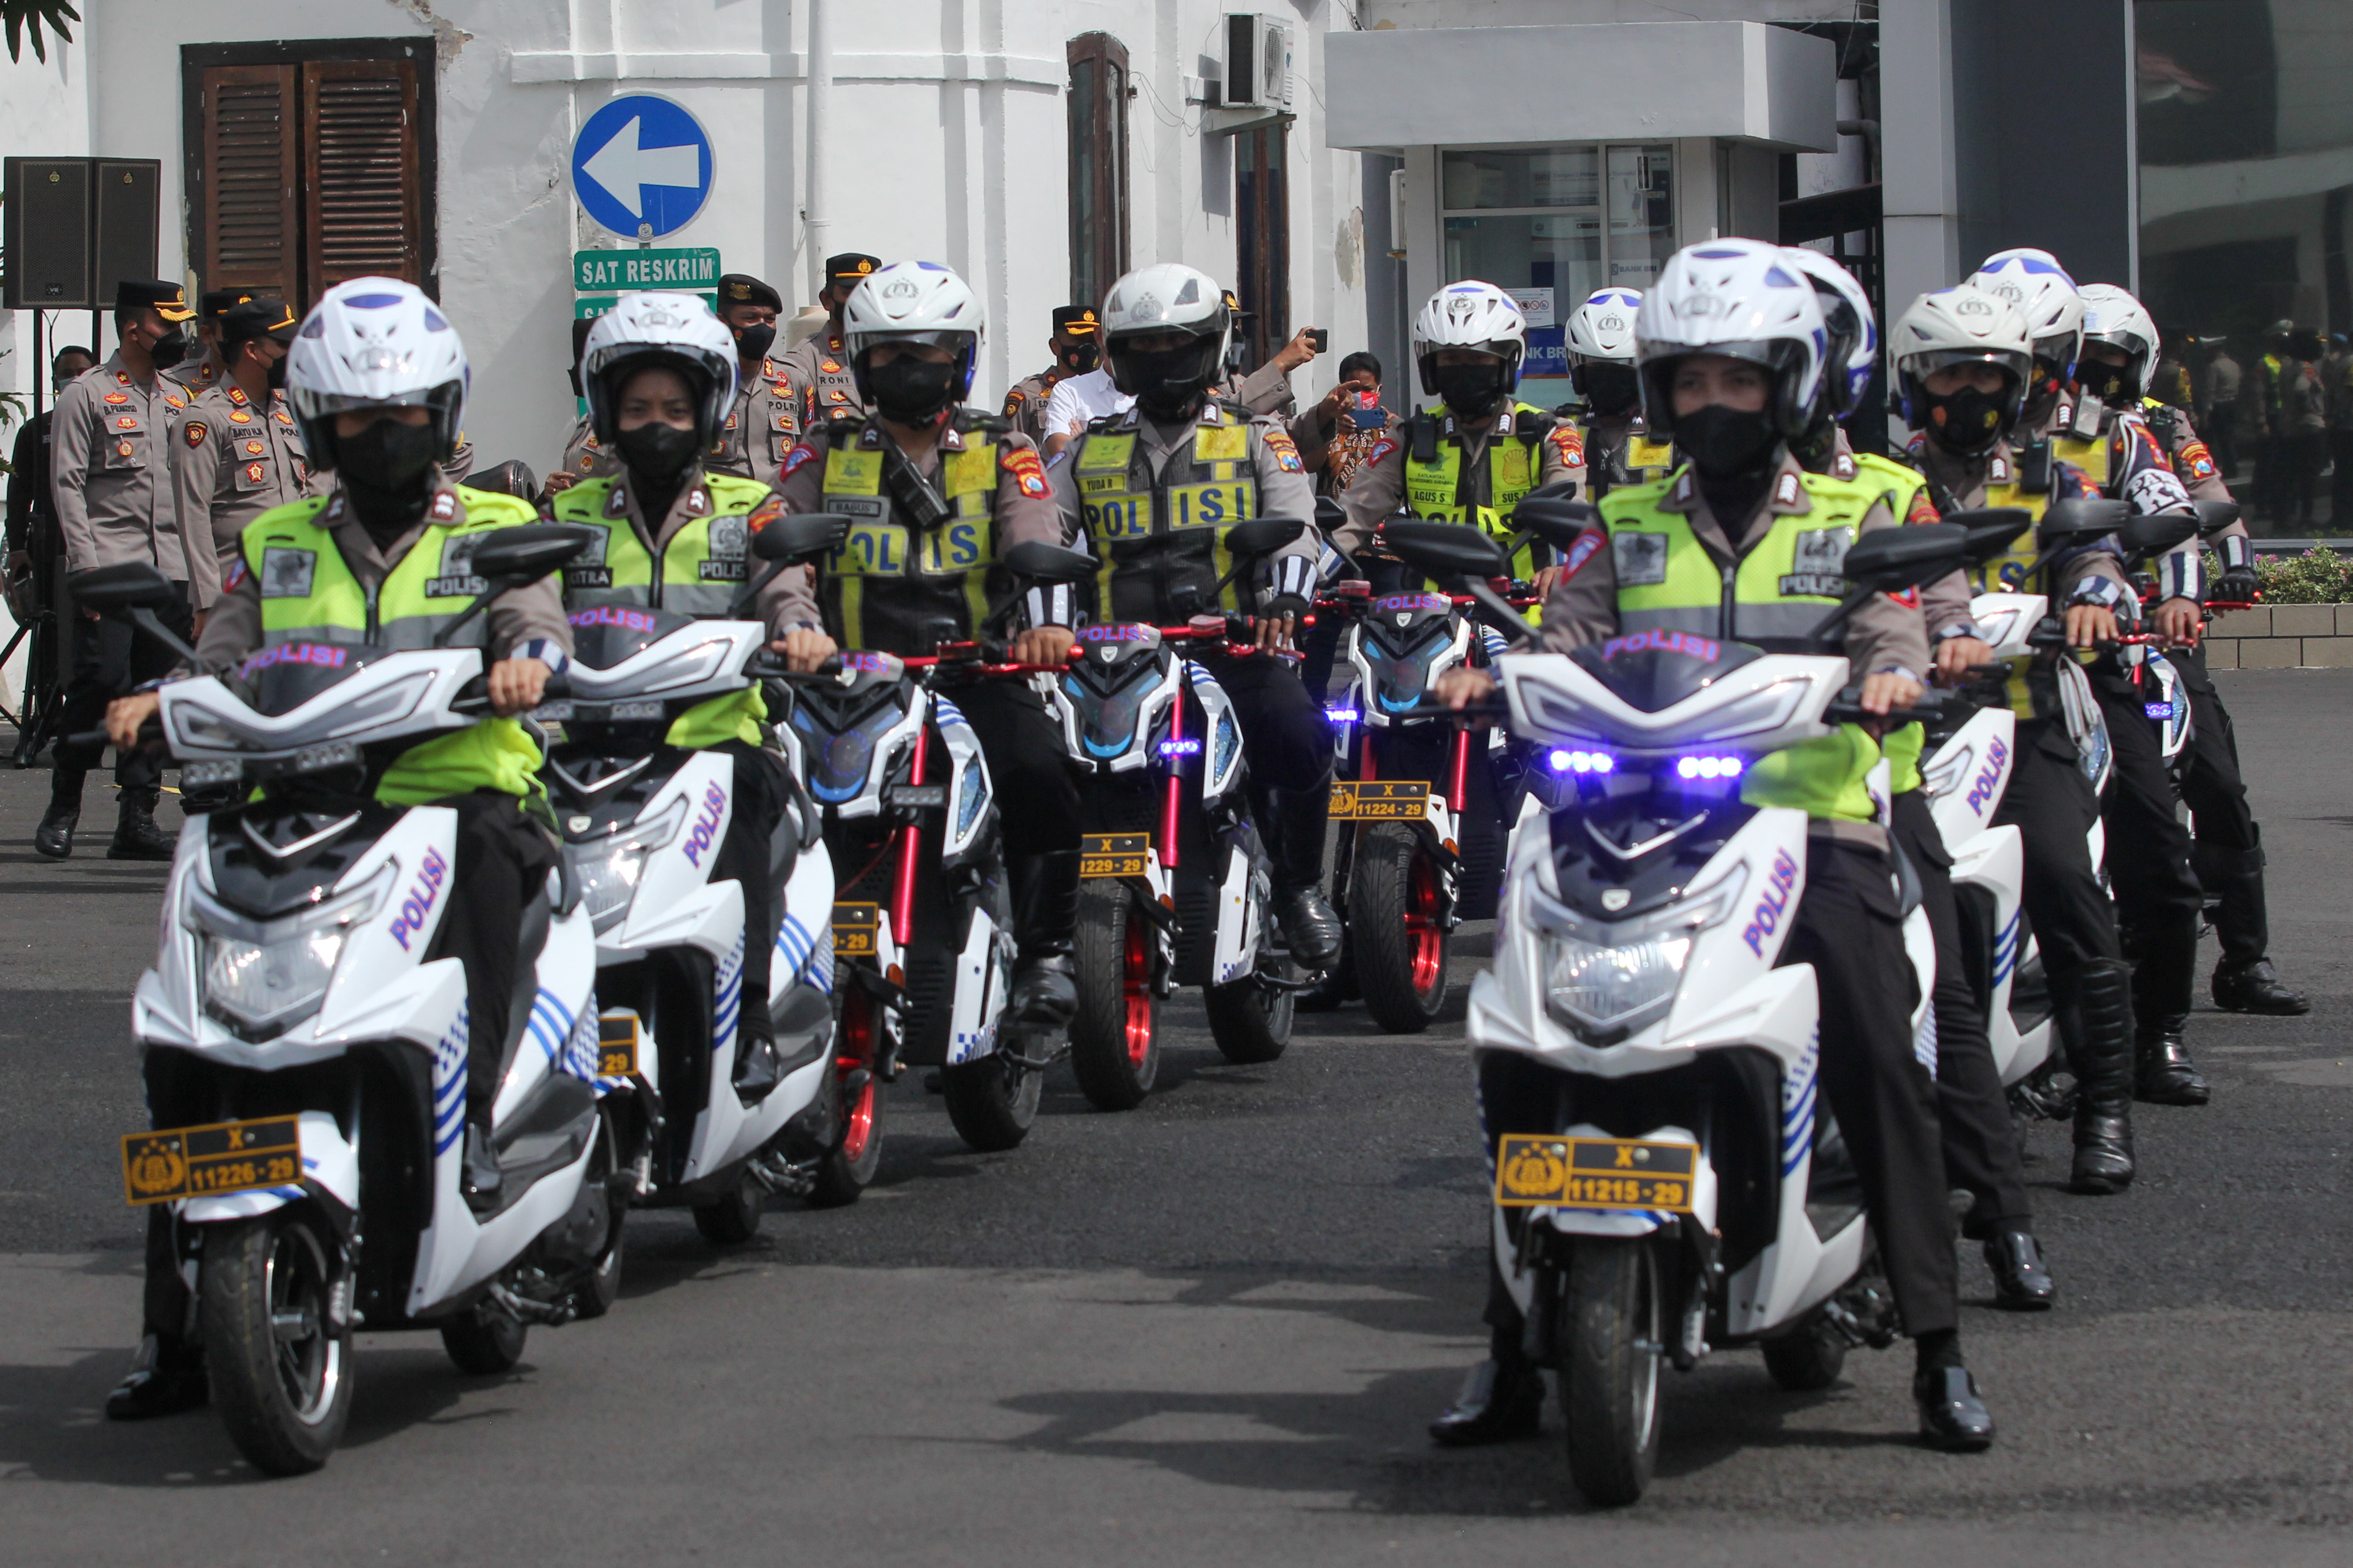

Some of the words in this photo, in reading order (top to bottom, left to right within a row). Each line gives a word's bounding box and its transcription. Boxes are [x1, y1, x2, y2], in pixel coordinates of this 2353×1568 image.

[582, 261, 619, 283] SAT
[627, 258, 713, 282] RESKRIM
[820, 376, 849, 385] RONI
[768, 401, 798, 412] POLRI
[1086, 479, 1105, 491] YUDA
[1106, 478, 1112, 489] R
[1414, 491, 1437, 502] AGUS
[1439, 493, 1445, 502] S
[1376, 593, 1443, 613] POLISI
[1075, 625, 1150, 644] POLISI
[1601, 627, 1721, 664] POLISI
[239, 642, 348, 680] POLISI
[1967, 733, 2008, 818] POLISI
[1383, 785, 1394, 796] X
[682, 779, 726, 870] POLISI
[1101, 838, 1113, 852] X
[389, 843, 448, 953] POLISI
[1742, 845, 1798, 959] POLISI
[227, 1127, 244, 1149] X
[1614, 1146, 1635, 1169] X
